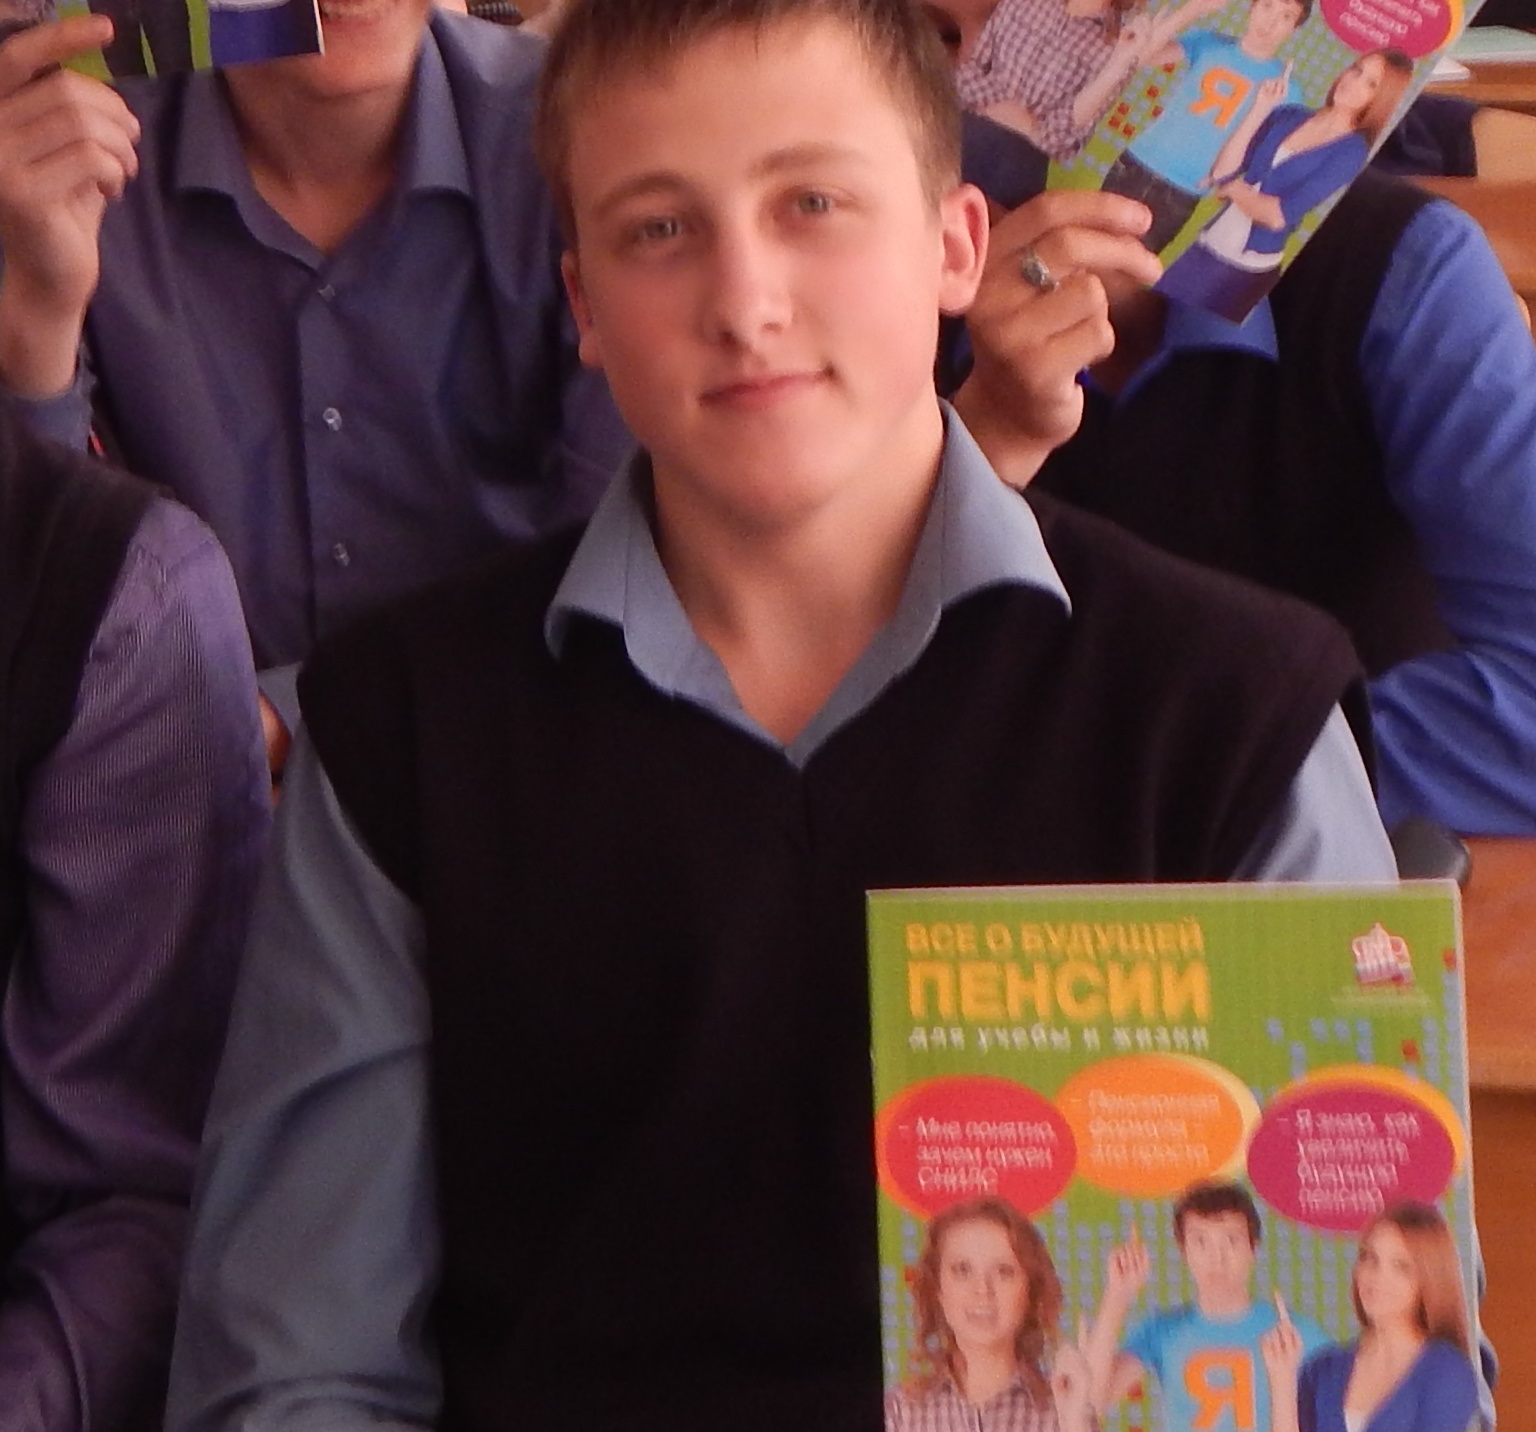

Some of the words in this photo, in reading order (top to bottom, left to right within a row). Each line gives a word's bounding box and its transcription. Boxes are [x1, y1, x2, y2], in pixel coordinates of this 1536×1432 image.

[1188, 67, 1252, 129] Я
[906, 922, 976, 954] ВСЕ
[985, 922, 1012, 953] О
[1020, 917, 1205, 960] БУДУЩЕЙ
[907, 959, 1210, 1022] ПЕНСИИ
[1184, 1347, 1255, 1430] Я
